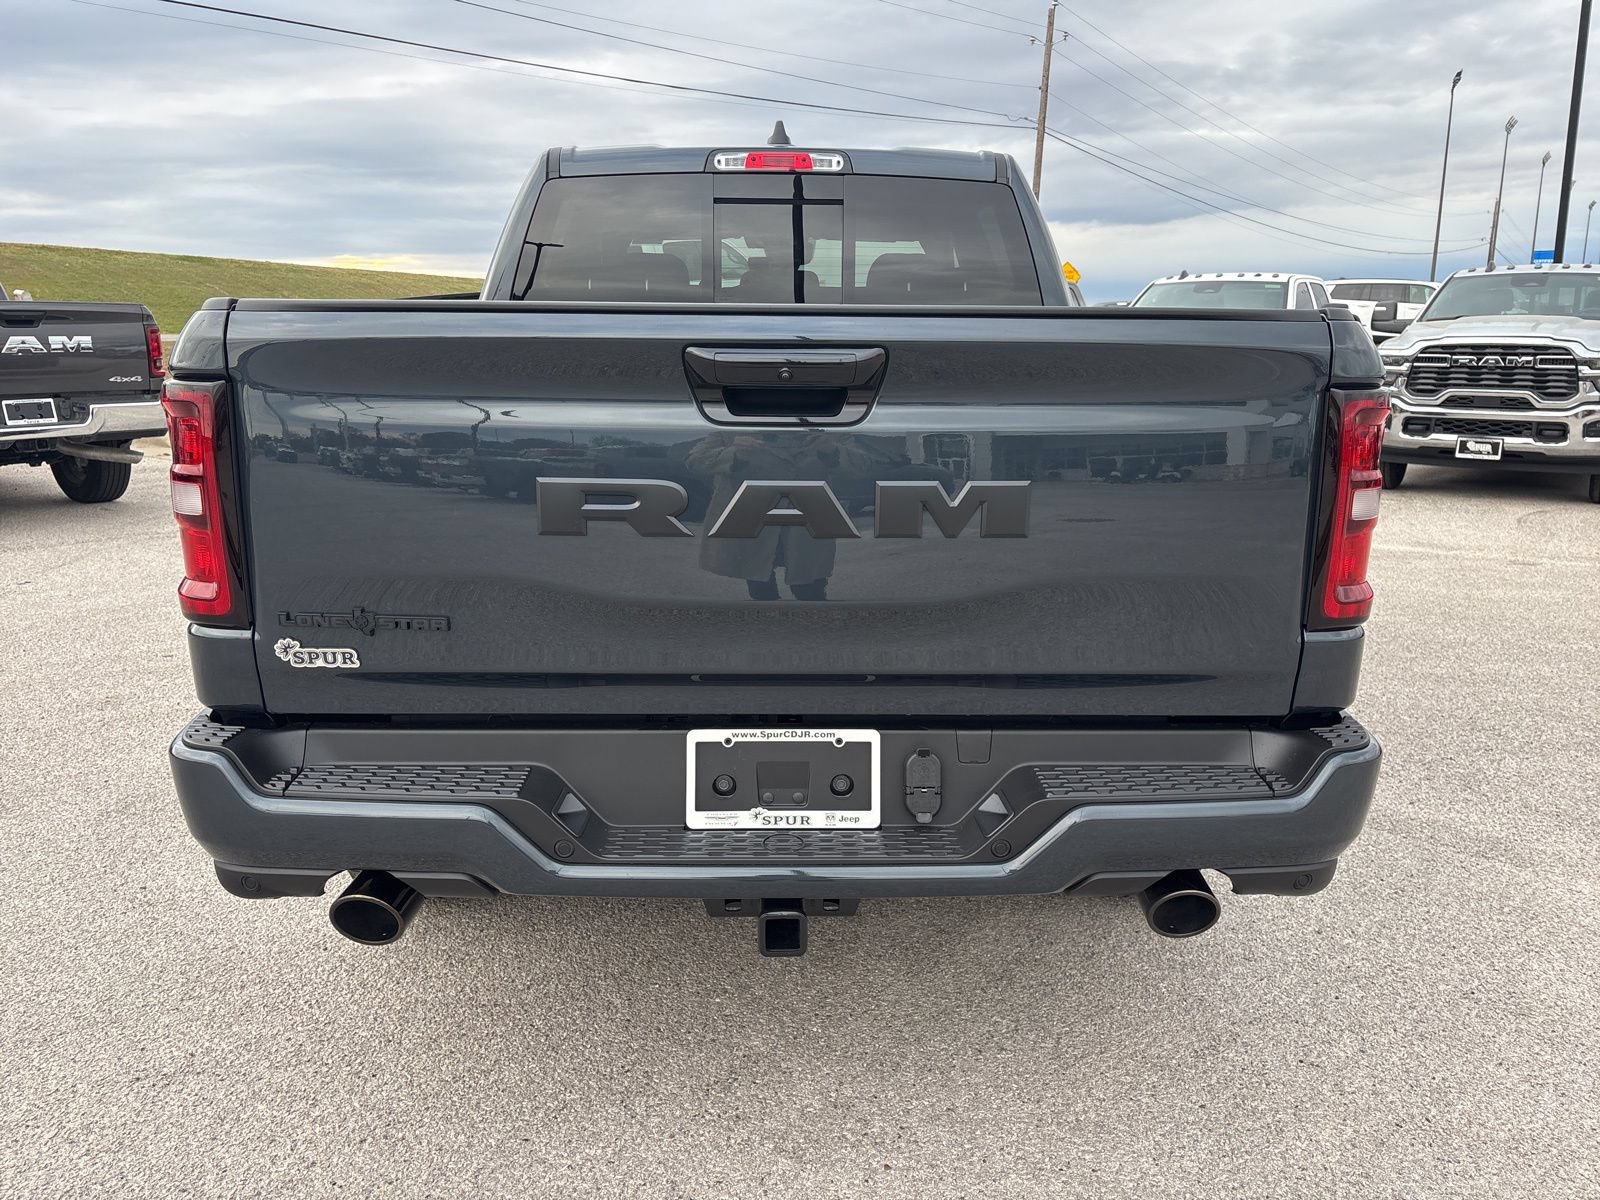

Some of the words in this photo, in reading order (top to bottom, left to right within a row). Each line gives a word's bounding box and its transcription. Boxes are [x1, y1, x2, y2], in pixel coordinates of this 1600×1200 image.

[1452, 355, 1534, 367] RAM
[109, 375, 143, 383] 4x4
[536, 477, 1031, 539] RAM
[278, 610, 352, 628] LONE
[375, 615, 450, 631] STAR
[292, 651, 356, 665] SPUR
[731, 730, 836, 740] www.SpurCDJR.com
[762, 815, 811, 826] SPUR
[838, 814, 860, 823] Jeep
